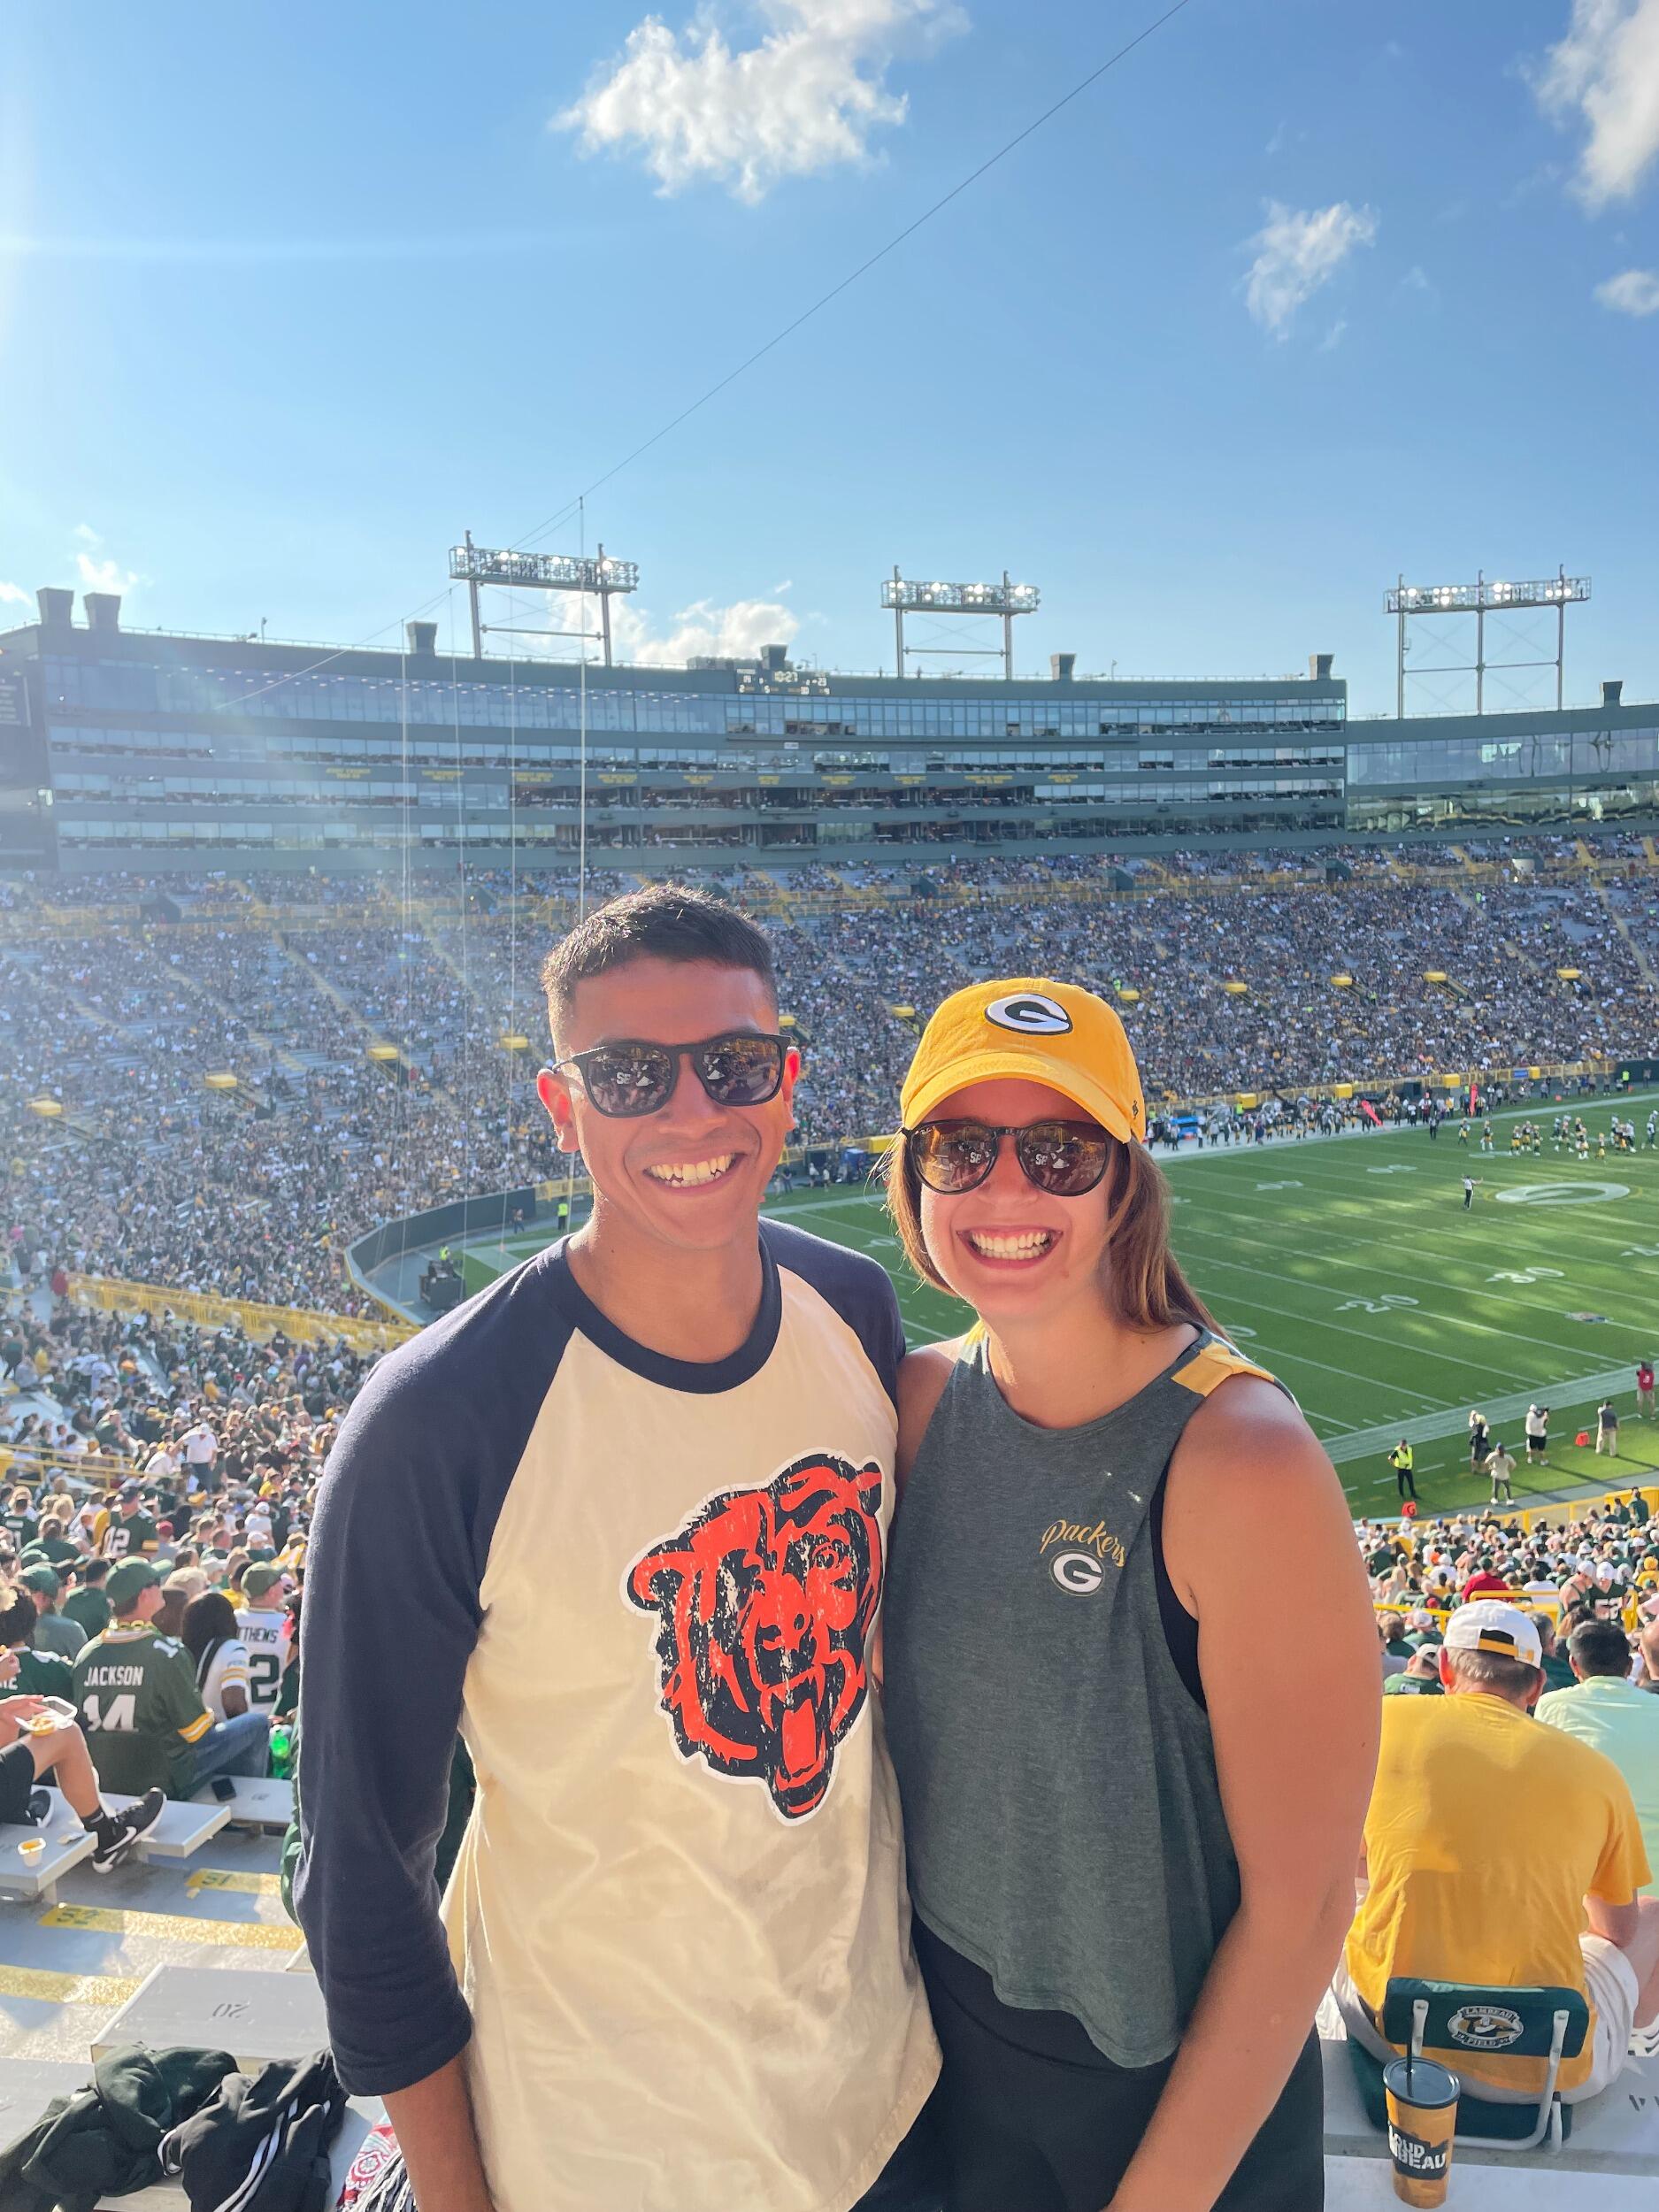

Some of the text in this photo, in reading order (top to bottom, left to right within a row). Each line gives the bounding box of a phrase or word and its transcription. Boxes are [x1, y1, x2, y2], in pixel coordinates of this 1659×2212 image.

[985, 994, 1073, 1035] G
[1494, 1266, 1565, 1284] 30
[1346, 1294, 1419, 1314] 20
[1039, 1519, 1126, 1568] Packers
[1051, 1550, 1104, 1595] G
[83, 1665, 144, 1686] JACKSON
[83, 1694, 139, 1732] 14
[1464, 2007, 1517, 2024] LAMBEAU
